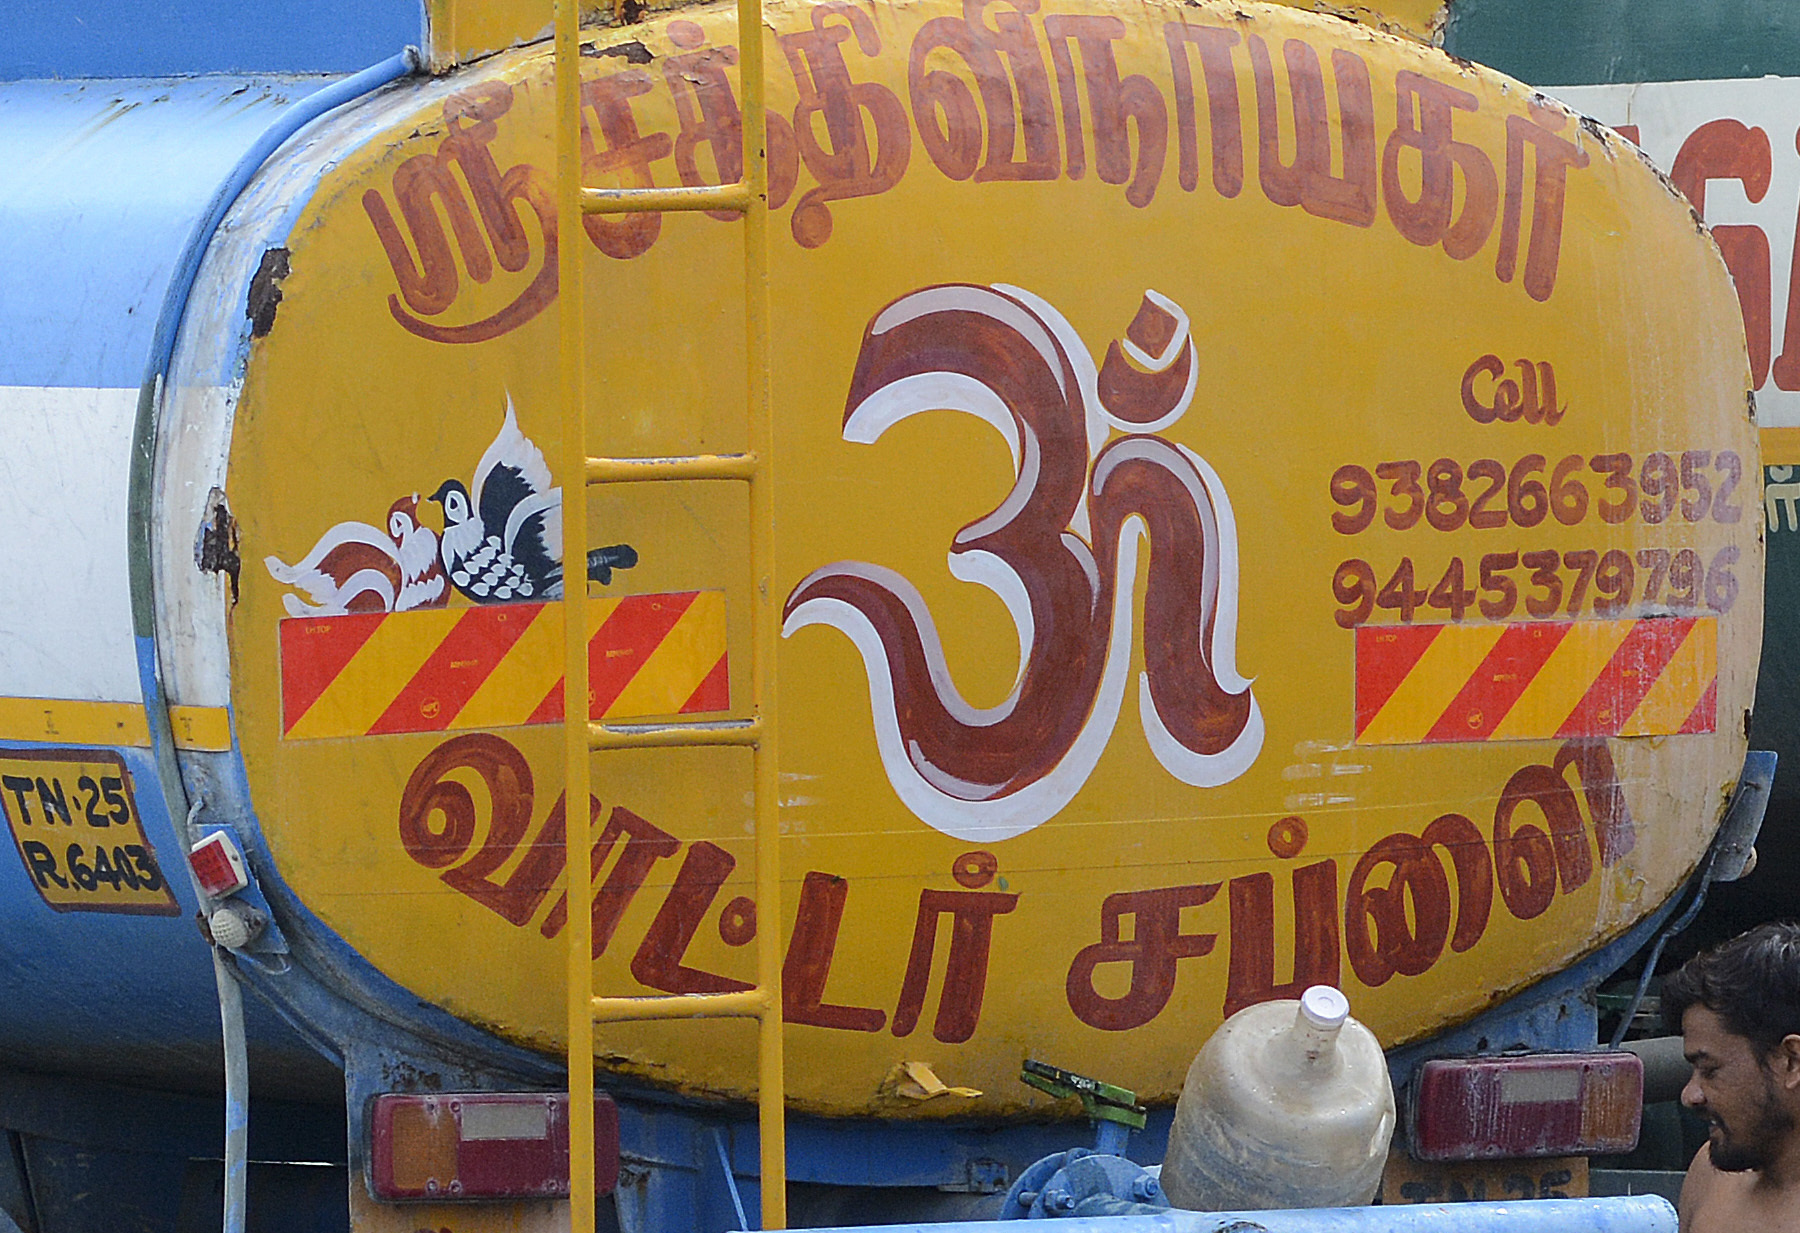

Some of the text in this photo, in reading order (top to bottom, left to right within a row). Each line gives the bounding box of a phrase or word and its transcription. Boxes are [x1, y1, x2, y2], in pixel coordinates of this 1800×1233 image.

[1460, 354, 1567, 427] Cell
[1330, 450, 1742, 535] 9382663952
[1332, 546, 1741, 629] 9445379796
